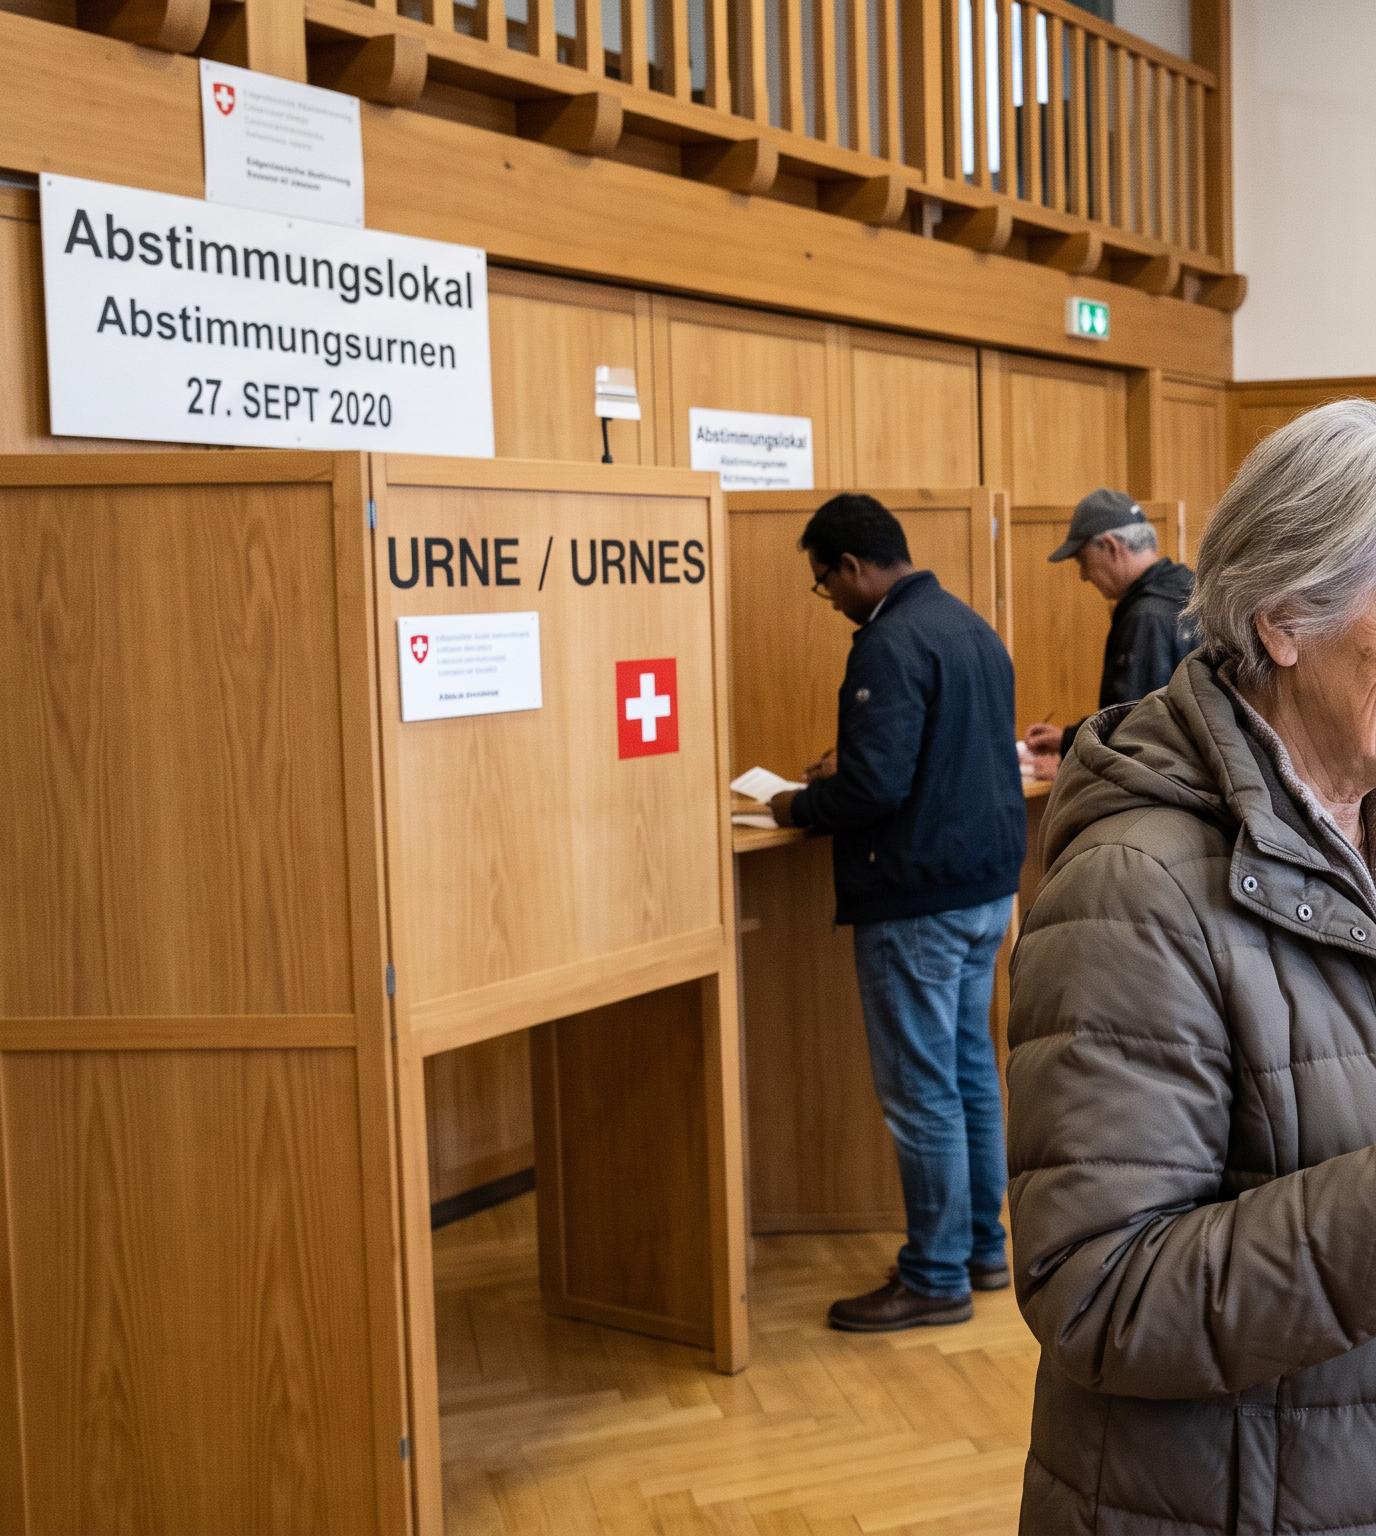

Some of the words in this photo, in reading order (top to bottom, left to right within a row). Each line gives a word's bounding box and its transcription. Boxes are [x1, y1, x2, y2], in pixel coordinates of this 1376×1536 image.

[64, 208, 475, 309] Abstimmungslokal
[97, 296, 457, 369] Abstimmungsurnen
[187, 377, 232, 416] 27.
[243, 382, 320, 422] SEPT
[330, 390, 393, 427] 2020
[697, 426, 807, 451] Abstimmungslokal
[387, 536, 521, 589] URNE
[538, 536, 553, 592] /
[570, 538, 706, 586] URNES
